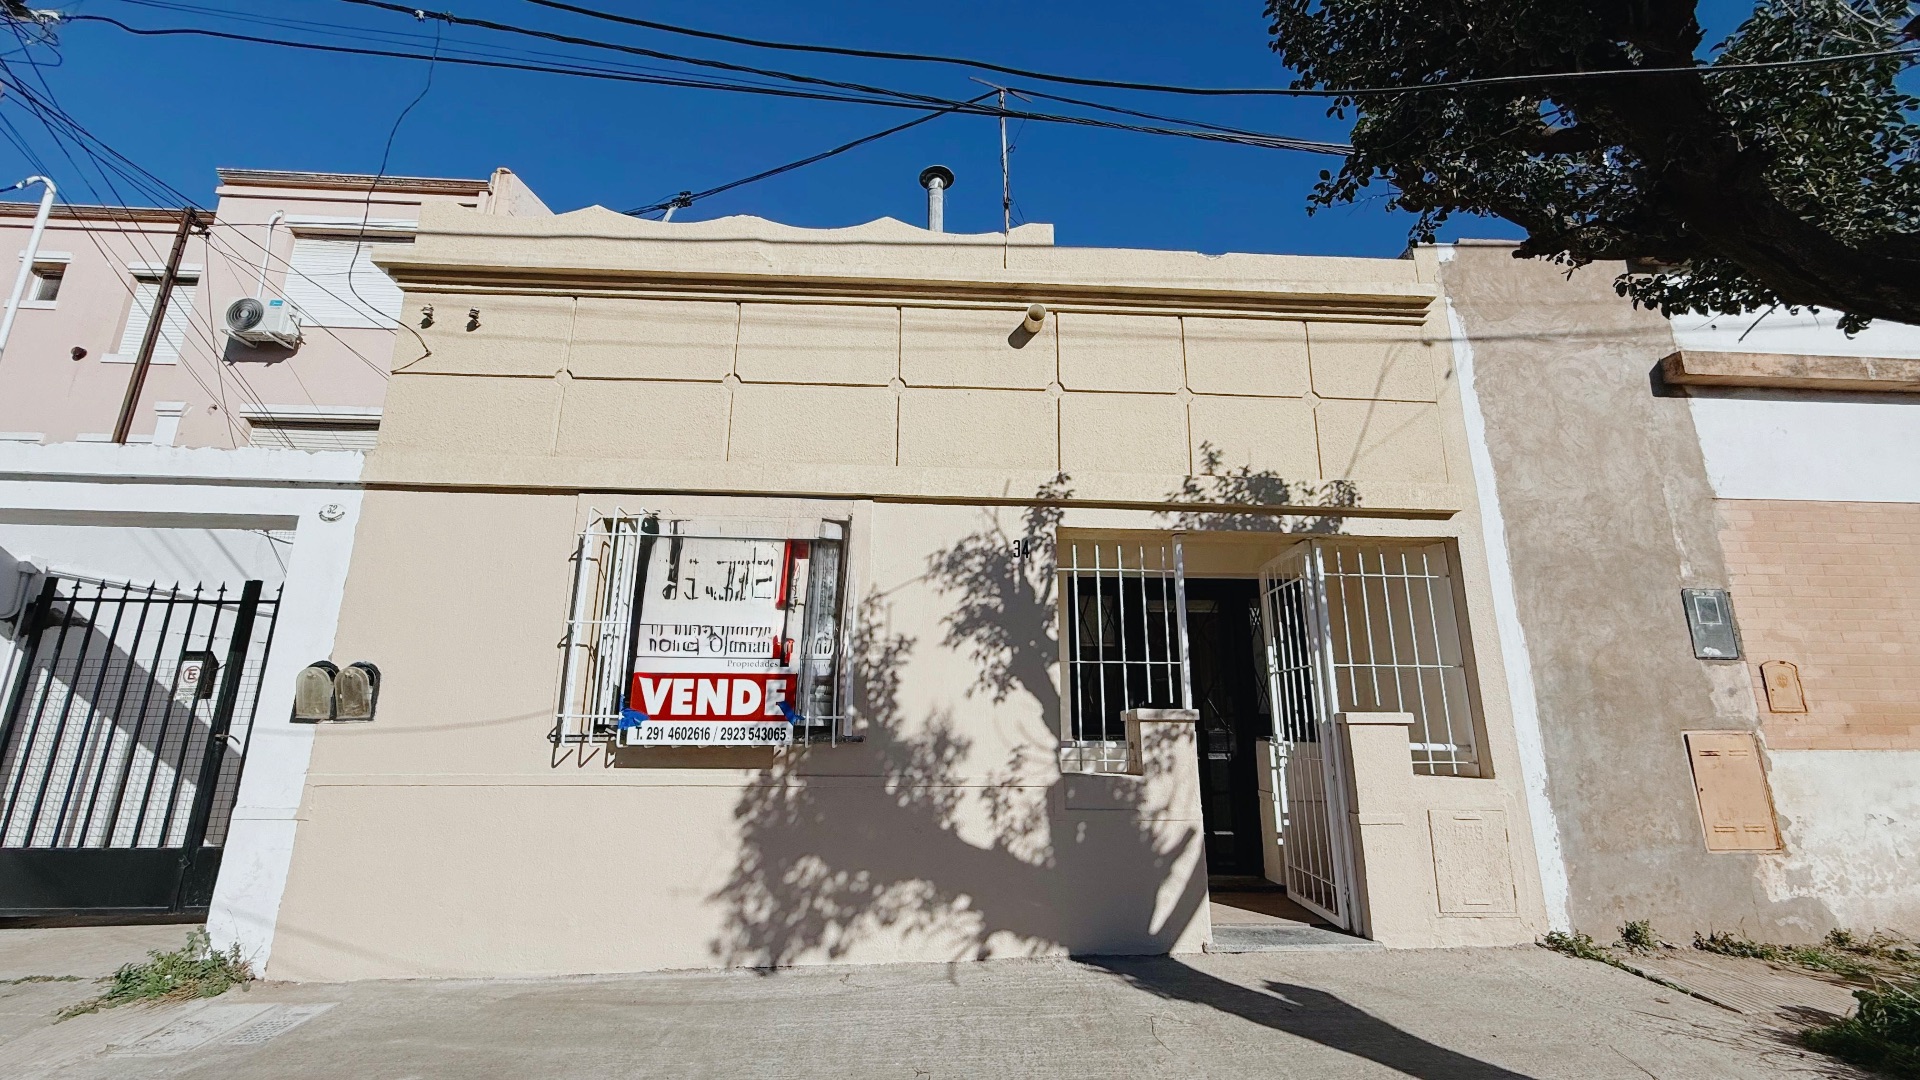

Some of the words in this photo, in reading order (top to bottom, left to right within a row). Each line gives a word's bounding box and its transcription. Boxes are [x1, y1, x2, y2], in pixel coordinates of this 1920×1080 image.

[1012, 539, 1030, 559] 34
[727, 659, 779, 669] Propiedades
[638, 676, 787, 716] VENDE
[635, 727, 643, 740] T.
[646, 726, 664, 740] 291
[668, 726, 710, 741] 4602616
[720, 727, 746, 741] 2923
[748, 727, 787, 741] 543065
